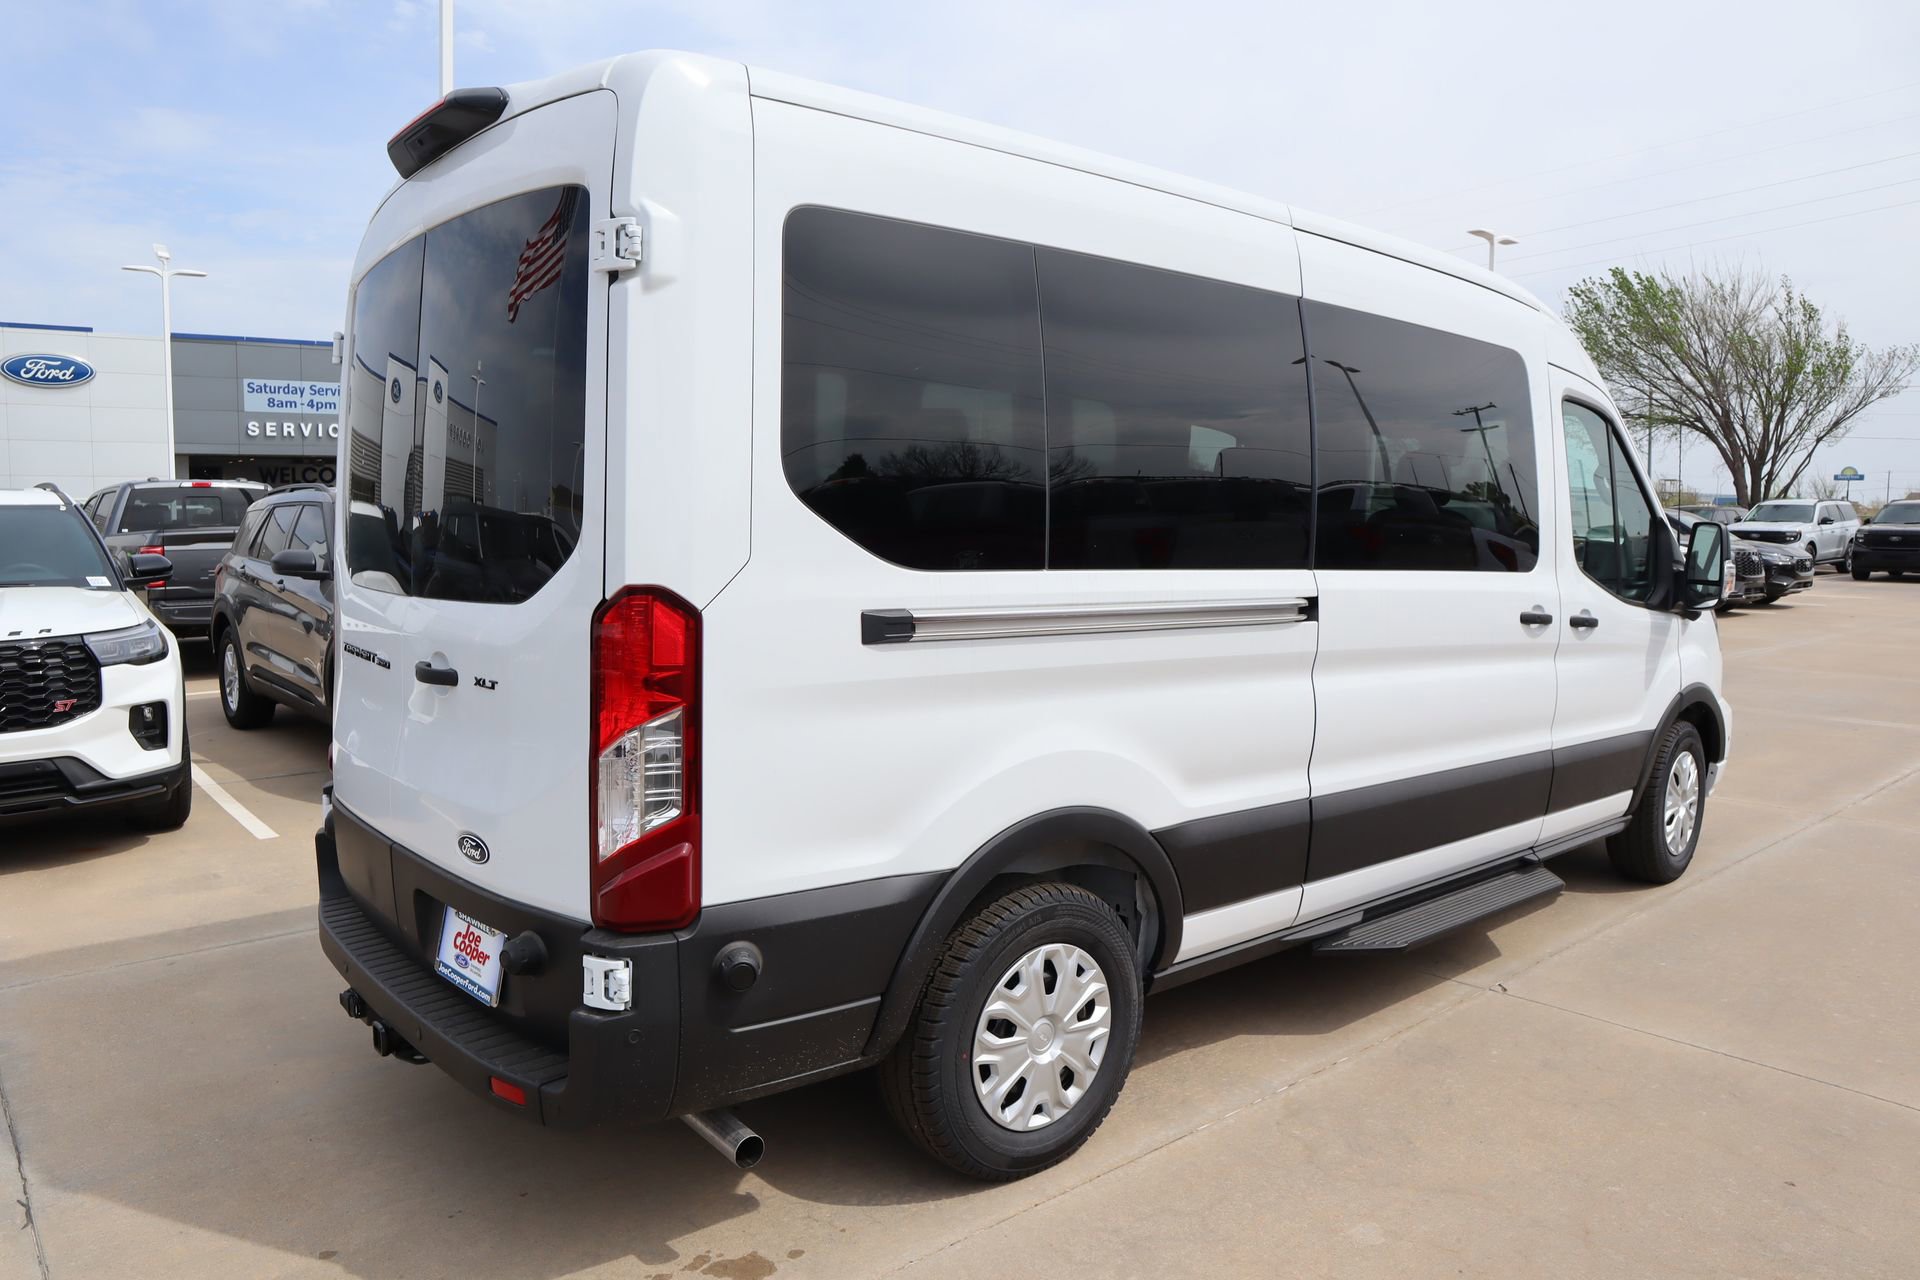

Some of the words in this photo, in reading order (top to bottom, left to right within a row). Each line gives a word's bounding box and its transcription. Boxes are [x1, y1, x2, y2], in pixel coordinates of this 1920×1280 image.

[20, 359, 75, 380] Ford
[247, 382, 305, 398] Saturday
[473, 676, 498, 690] XLT
[53, 699, 77, 712] ST
[461, 837, 481, 860] Ford
[458, 911, 490, 934] SHAWNEE
[462, 924, 482, 947] Joe
[453, 931, 490, 966] Cooper
